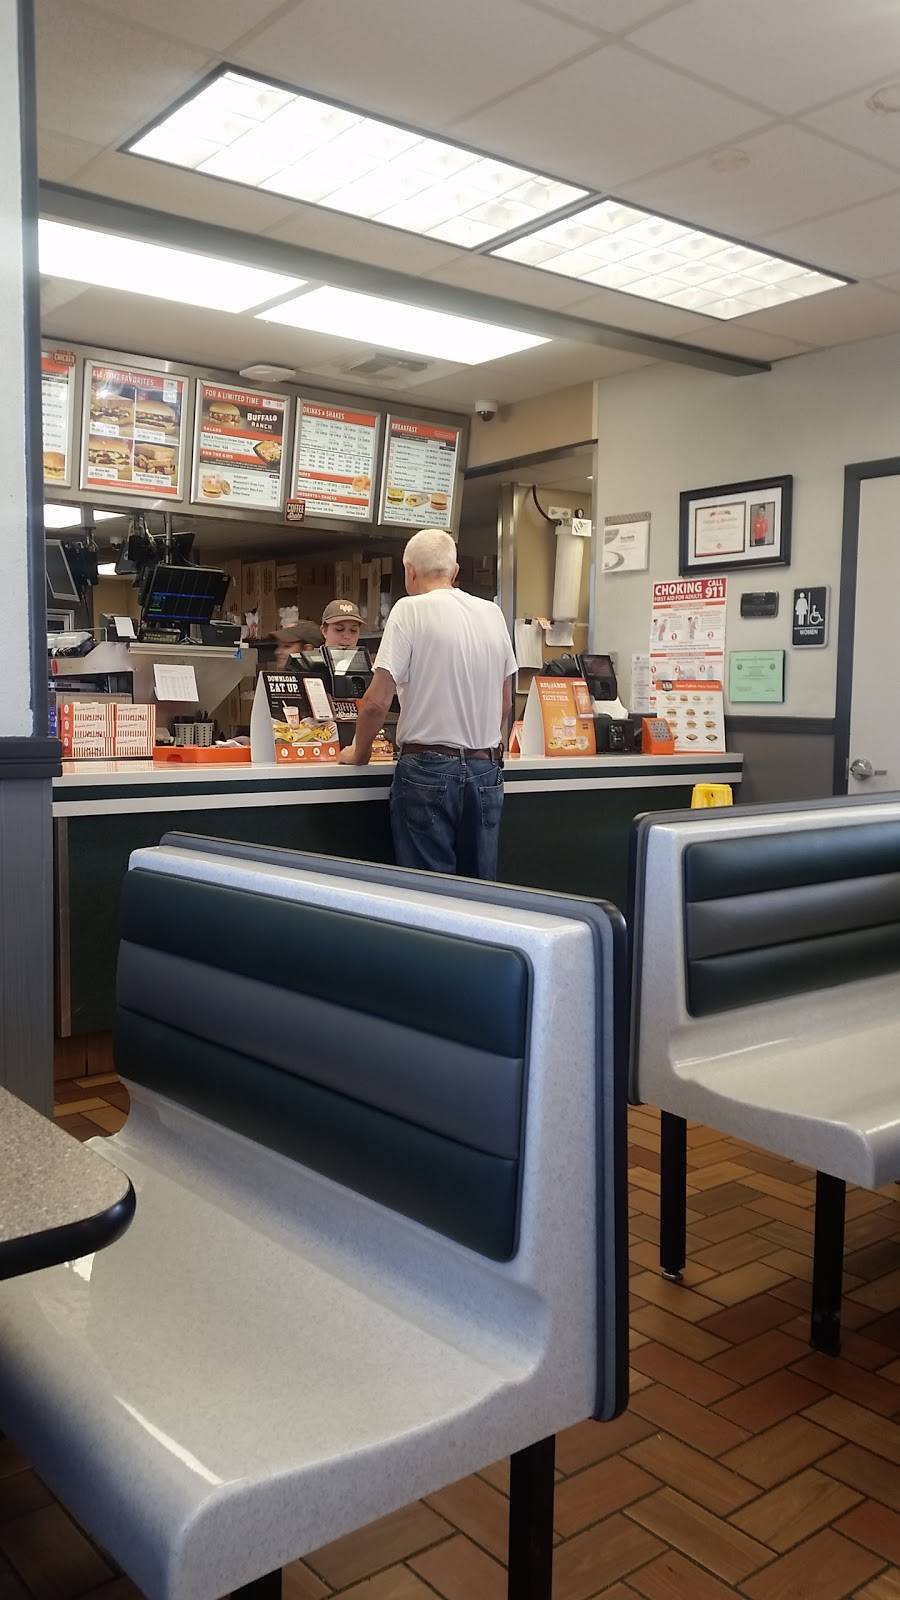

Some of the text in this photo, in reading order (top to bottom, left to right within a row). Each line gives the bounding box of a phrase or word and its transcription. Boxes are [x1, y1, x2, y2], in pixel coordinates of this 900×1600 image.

[121, 374, 154, 386] FAVORITES
[205, 389, 216, 398] FOR
[222, 392, 245, 402] LIMITED
[246, 396, 259, 405] TIME
[247, 412, 278, 422] BUFFALO
[303, 406, 321, 416] DRINKS
[326, 410, 345, 420] SHAKES
[251, 421, 273, 430] RANCH
[391, 422, 418, 433] BREAKFAST
[287, 503, 305, 513] COFFEE
[655, 581, 702, 596] CHOKING
[707, 579, 723, 587] CALL
[685, 592, 703, 600] ADULTS
[705, 586, 724, 598] 911
[269, 683, 300, 693] EAT UP.
[332, 701, 358, 712] COFFEE
